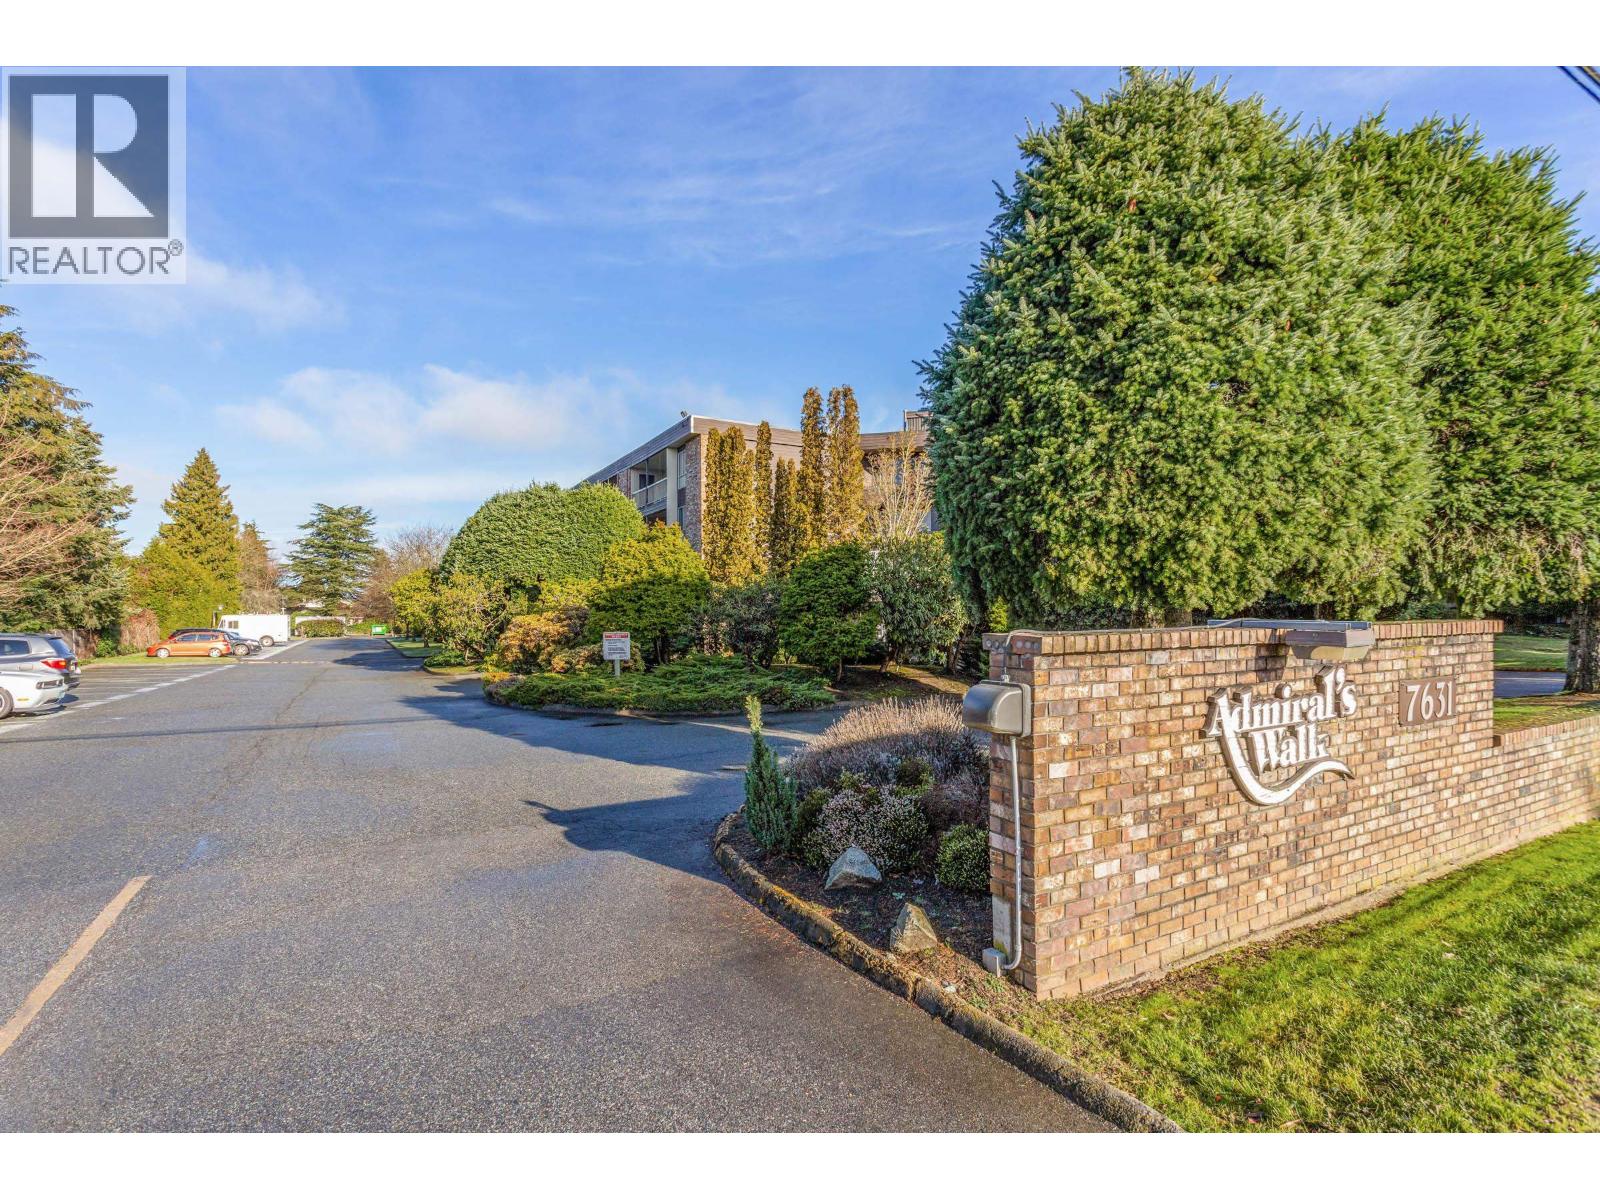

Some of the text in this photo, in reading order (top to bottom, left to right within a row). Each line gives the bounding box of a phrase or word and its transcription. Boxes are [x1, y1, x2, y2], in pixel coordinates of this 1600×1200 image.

[1202, 666, 1357, 738] Admiral's
[1406, 681, 1453, 722] 7631
[1250, 722, 1331, 775] Walk
